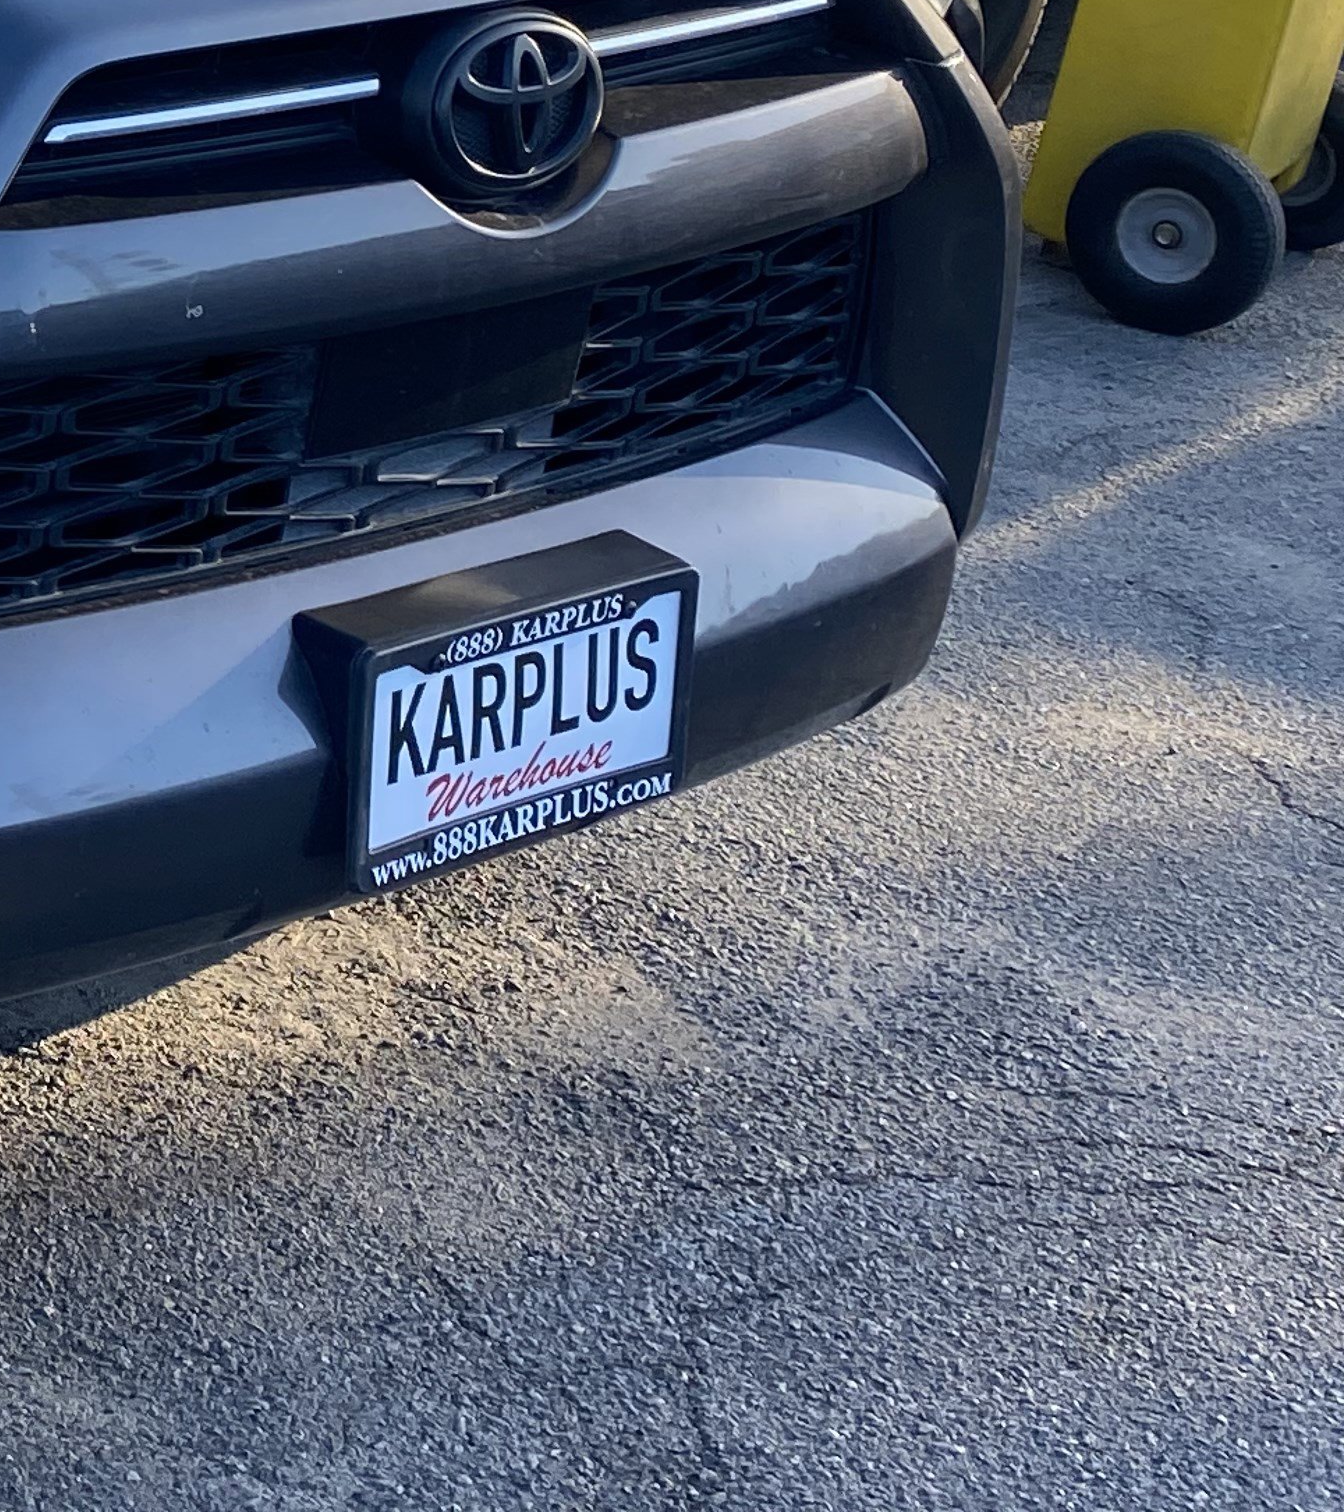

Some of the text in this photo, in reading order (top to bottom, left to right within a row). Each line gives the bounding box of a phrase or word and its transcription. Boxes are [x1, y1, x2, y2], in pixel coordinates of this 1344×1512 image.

[445, 592, 624, 664] (888) KARPLUS
[386, 618, 660, 786] KARPLUS
[425, 738, 614, 823] Warehouse
